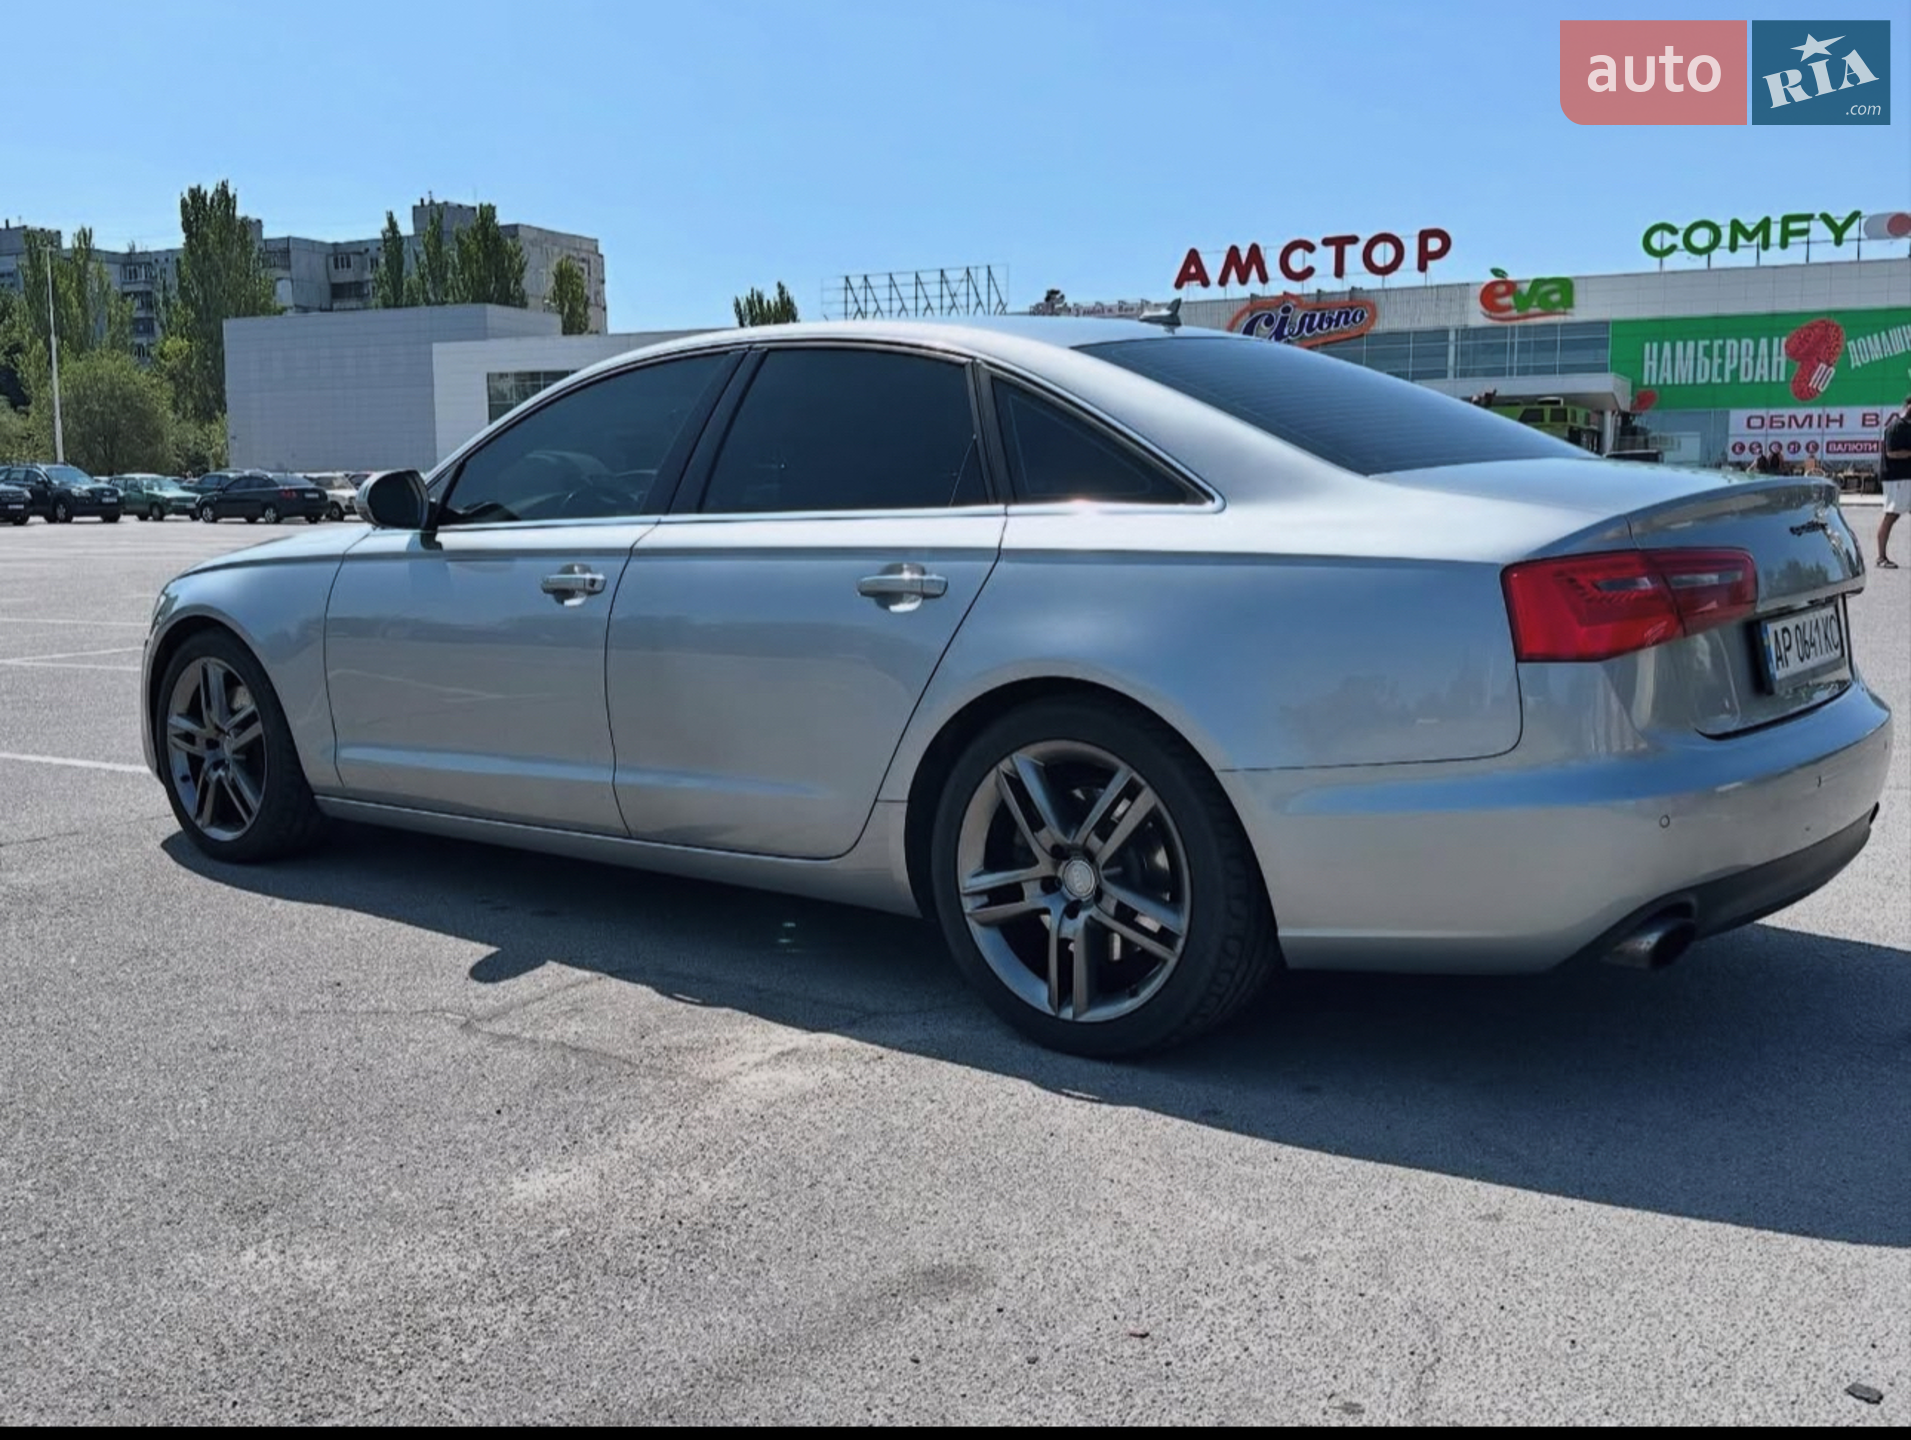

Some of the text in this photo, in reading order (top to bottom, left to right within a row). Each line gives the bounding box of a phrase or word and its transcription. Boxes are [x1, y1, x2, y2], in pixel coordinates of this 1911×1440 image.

[1642, 210, 1861, 258] COMFY
[1174, 227, 1452, 290] АМСТОР
[1242, 303, 1370, 342] Сільпо
[1643, 337, 1786, 386] НАМБЕРВАН
[1808, 362, 1836, 393] ПО
[1746, 412, 1844, 430] ОБМІН
